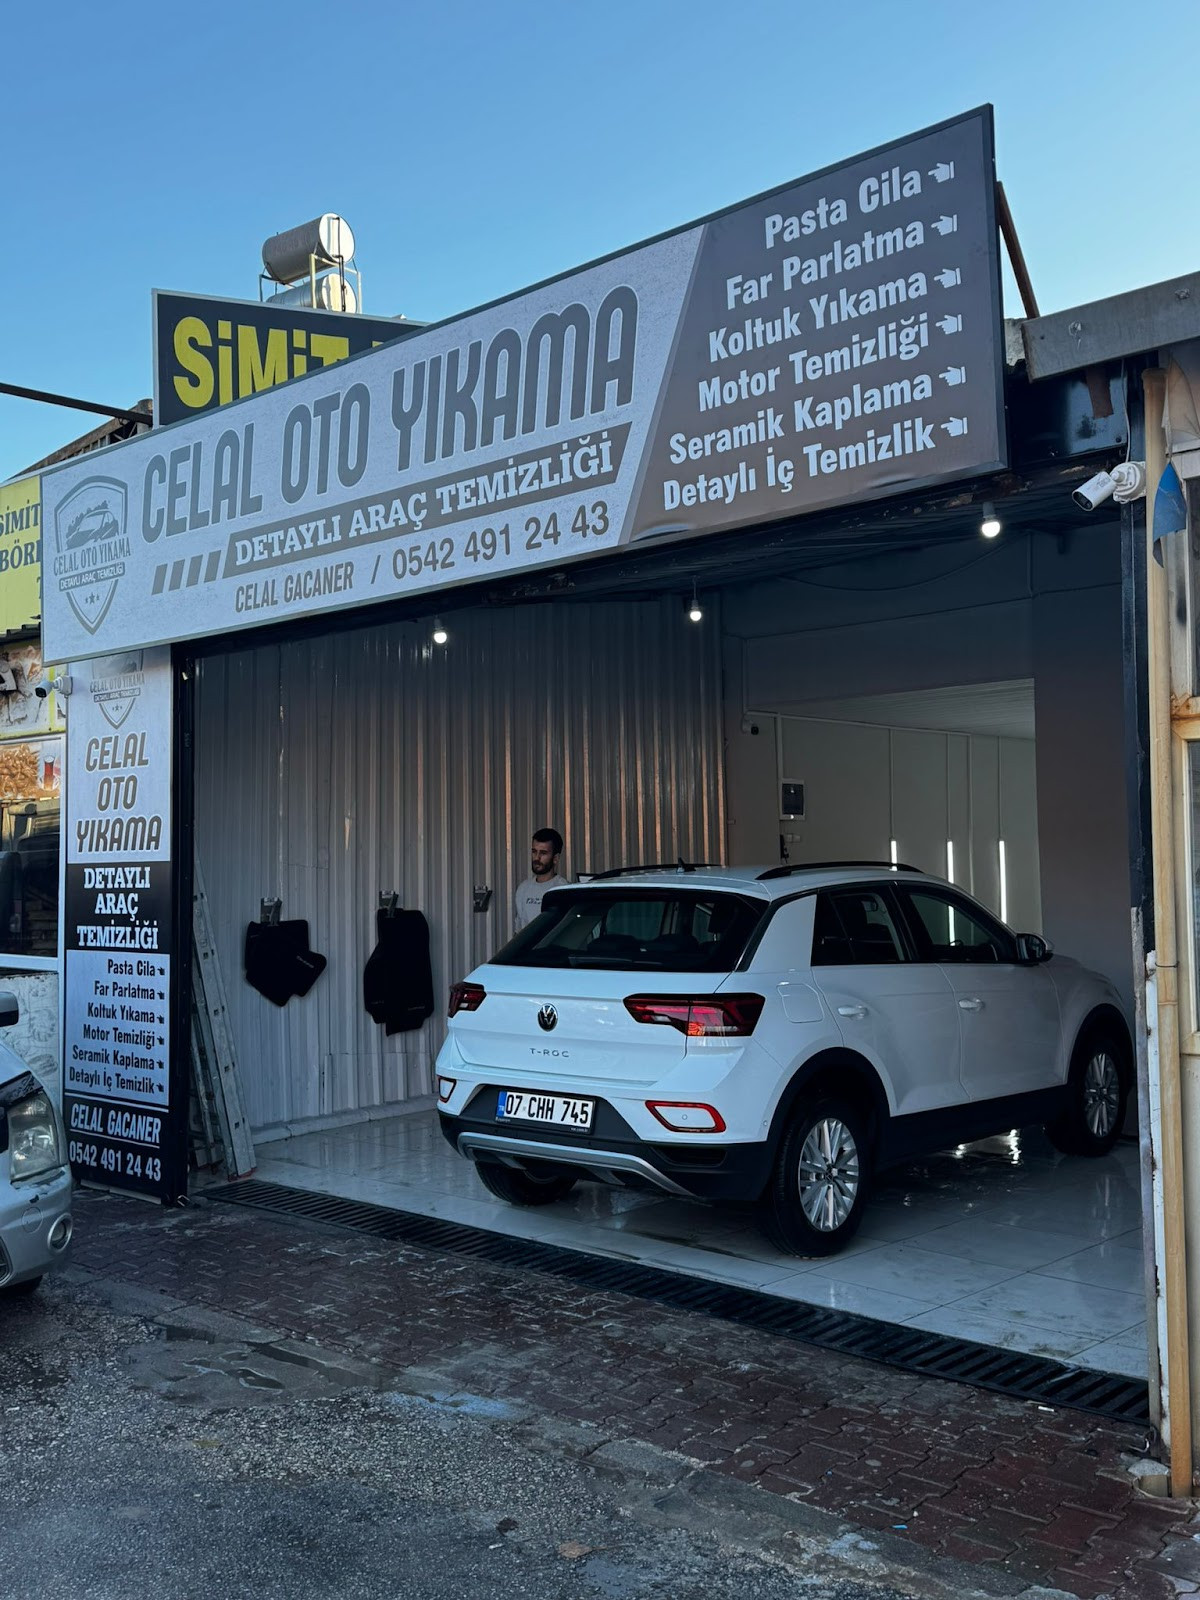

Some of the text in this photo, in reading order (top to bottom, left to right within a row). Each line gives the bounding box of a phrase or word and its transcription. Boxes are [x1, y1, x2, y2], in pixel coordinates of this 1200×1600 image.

[764, 166, 922, 249] Pasta Cila
[726, 220, 925, 310] Far Parlatma
[709, 271, 927, 362] Koltuk Yıkama
[699, 312, 929, 412] Motor Temizliği
[141, 285, 639, 543] CELAL OTO YIKAMA
[669, 373, 932, 464] Seramik Kaplama
[663, 418, 936, 511] Detaylı İç Temizlik
[235, 432, 613, 566] DETAYLI ARAÇ TEMİZLİĞİ
[53, 537, 131, 576] CELAL OTO YIKAMA
[235, 578, 278, 613] CELAL
[284, 561, 354, 603] GACANER
[392, 537, 455, 579] 0542
[463, 523, 510, 562] 491
[525, 512, 561, 550] 24
[571, 500, 609, 539] 43
[85, 731, 150, 772] CELAL
[96, 774, 138, 812] OTO
[76, 815, 162, 853] YIKAMA
[84, 866, 150, 889] DETAYLI
[95, 893, 138, 921] ARAÇ
[77, 919, 158, 949] TEMİZLİĞİ
[107, 959, 155, 976] Pasta Cila
[94, 980, 155, 1000] Far Parlatma
[87, 1002, 155, 1023] Koltuk Yıkama
[83, 1024, 155, 1050] Motor Temizliği
[529, 1047, 569, 1058] T-ROC
[72, 1045, 155, 1070] Seramik Kaplama
[69, 1066, 155, 1094] Detaylı İç Temizlik
[70, 1103, 162, 1144] CELAL GACANER
[505, 1094, 523, 1116] 07
[528, 1096, 555, 1120] CHH
[560, 1100, 589, 1124] 745
[69, 1140, 161, 1182] 0542 491 24 43
